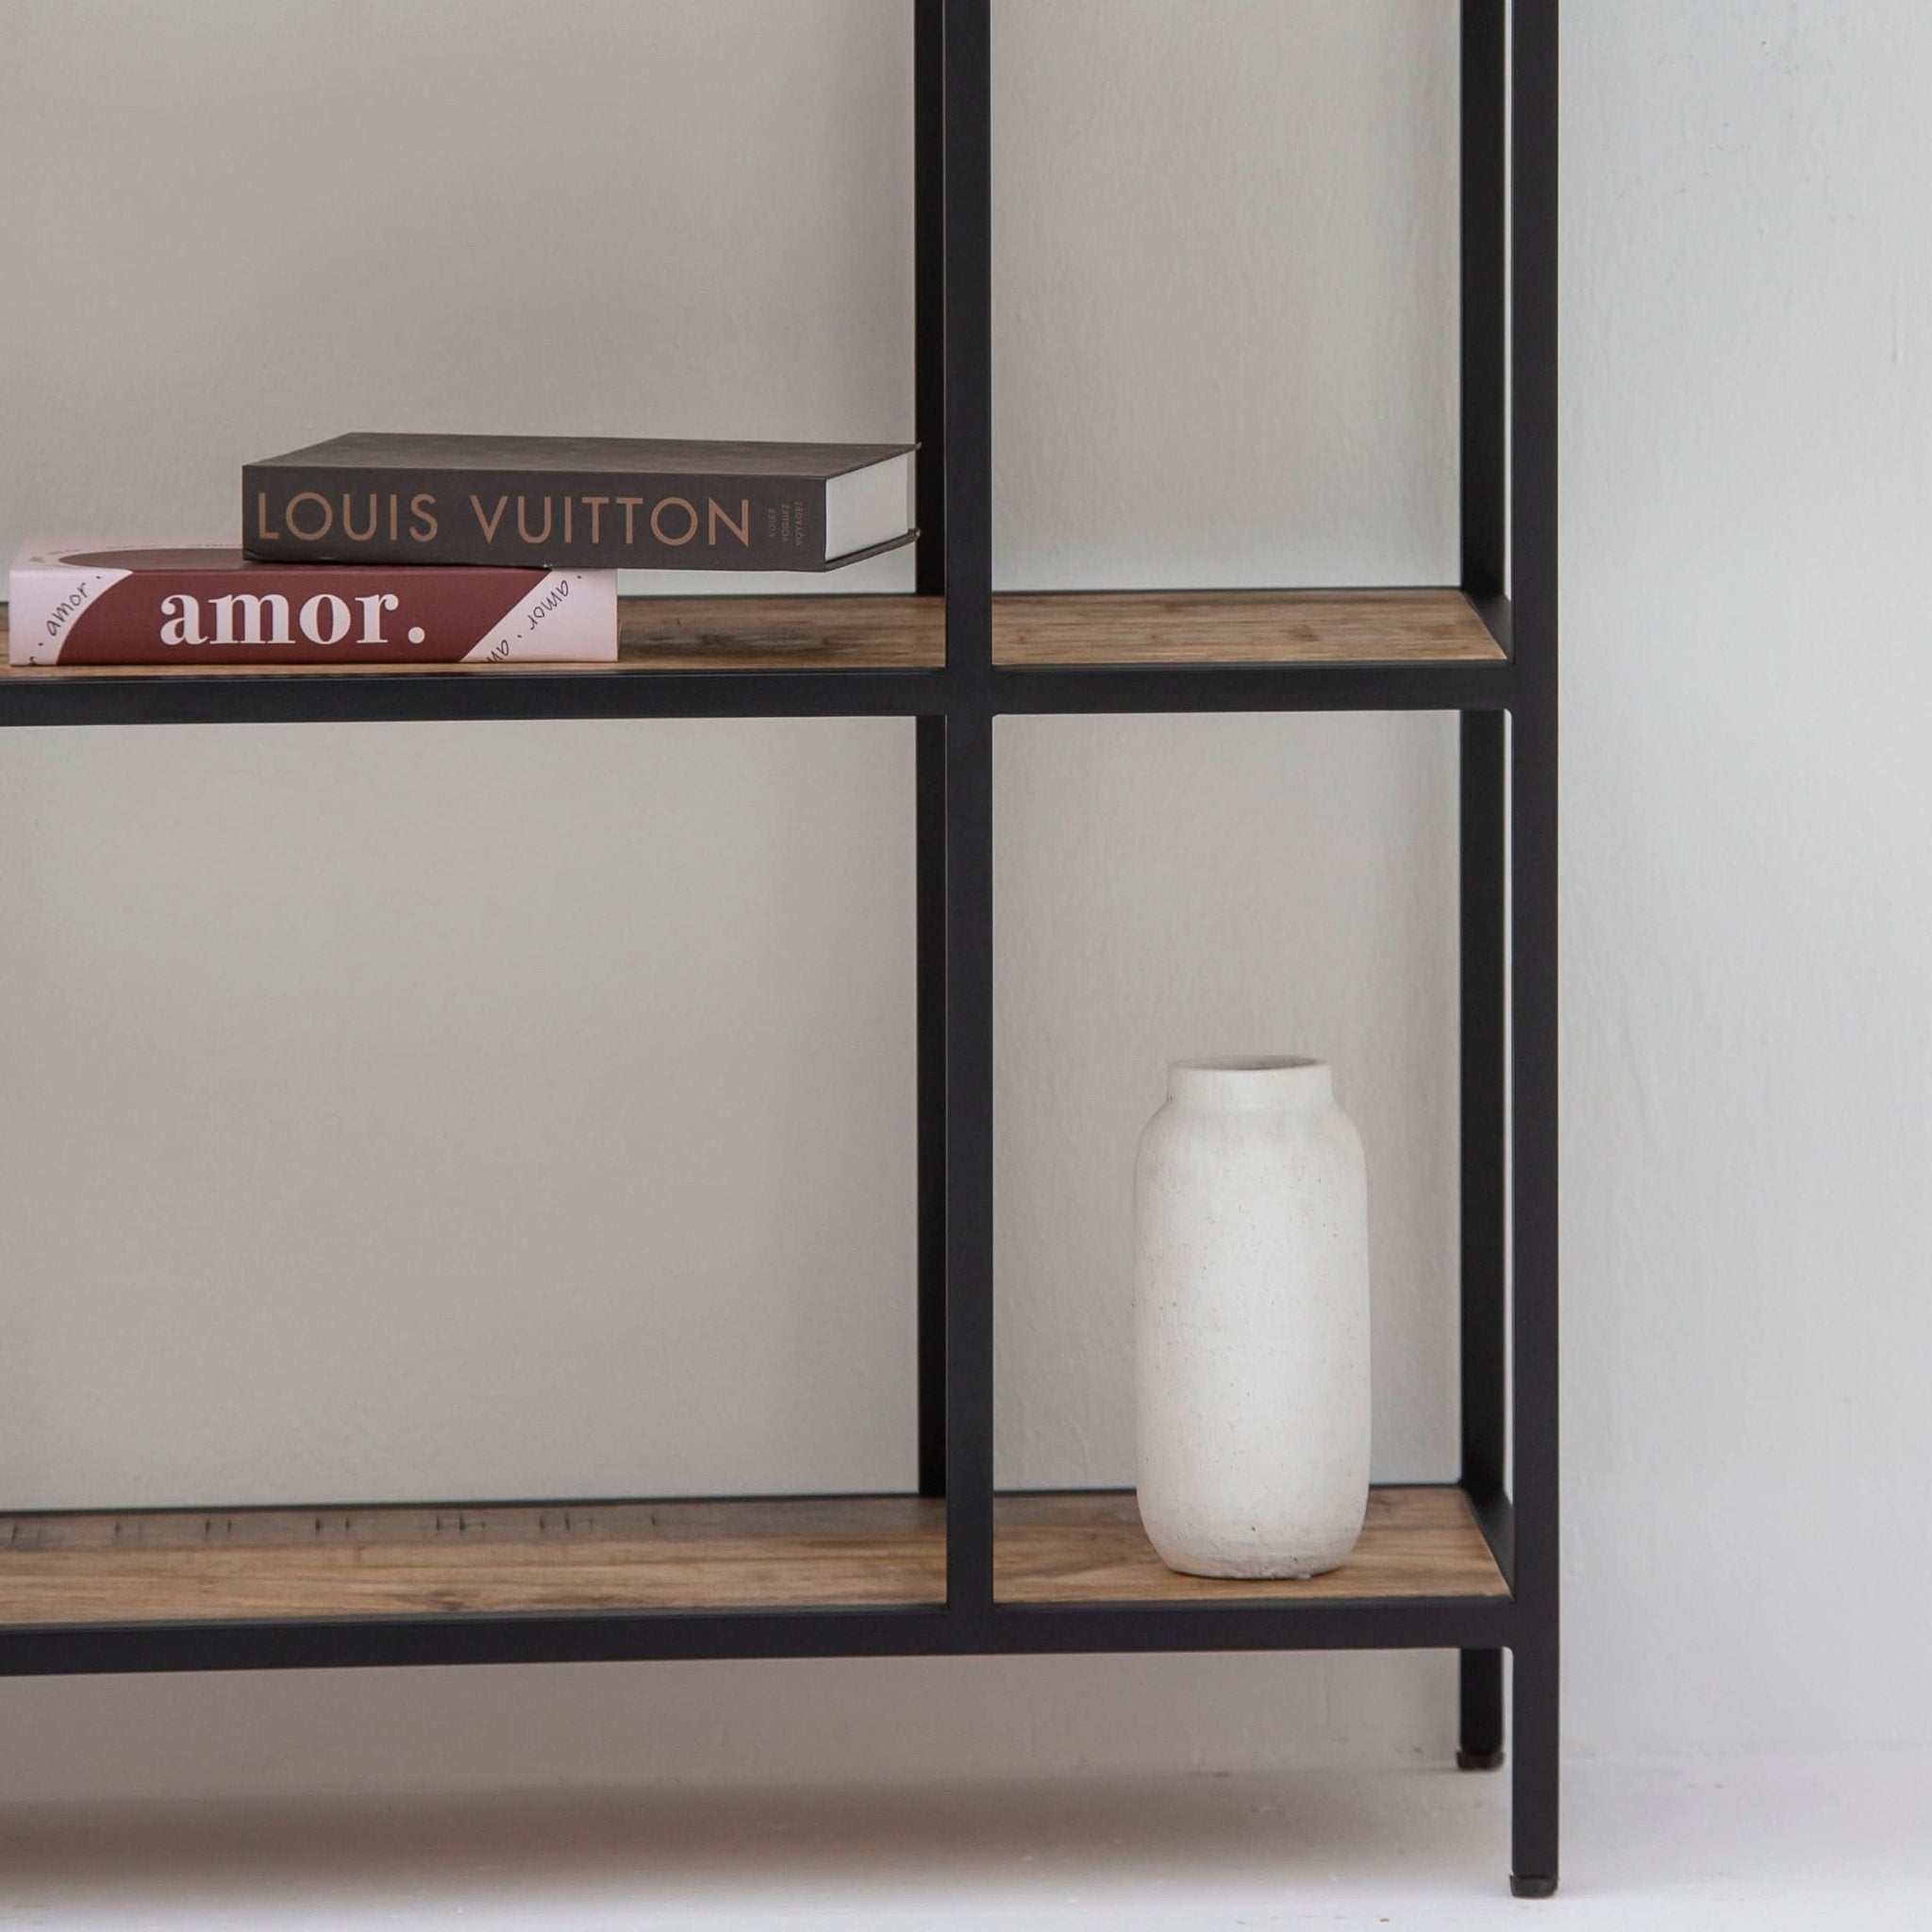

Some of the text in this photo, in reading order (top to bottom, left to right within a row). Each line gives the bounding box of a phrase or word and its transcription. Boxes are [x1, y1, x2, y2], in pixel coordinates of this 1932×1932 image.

[258, 491, 750, 548] LOUIS VUITTON
[46, 582, 88, 637] amor
[159, 593, 425, 645] amor.
[529, 579, 570, 630] amor
